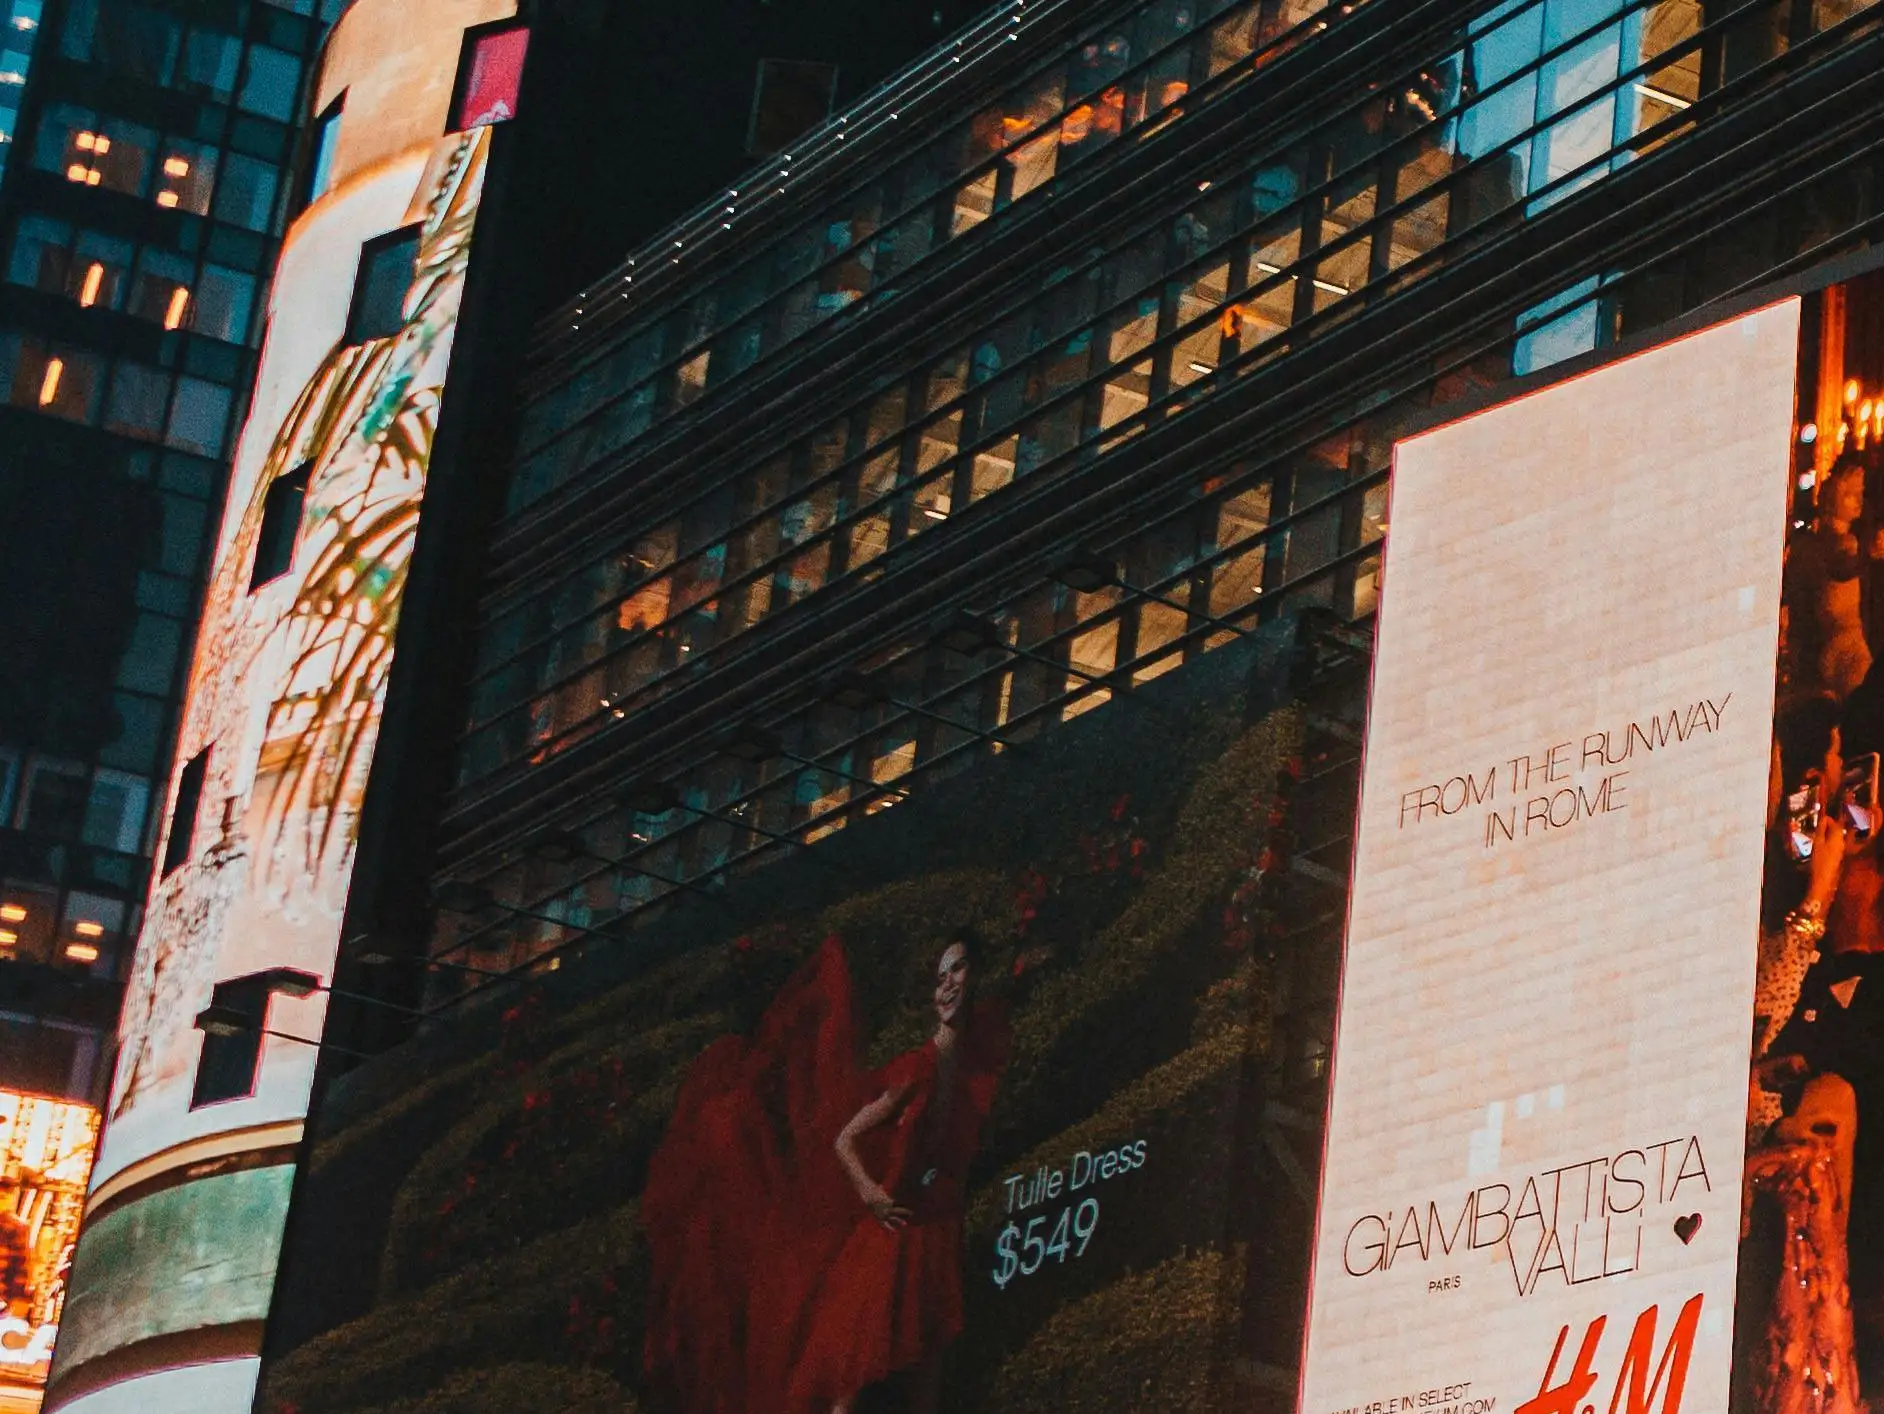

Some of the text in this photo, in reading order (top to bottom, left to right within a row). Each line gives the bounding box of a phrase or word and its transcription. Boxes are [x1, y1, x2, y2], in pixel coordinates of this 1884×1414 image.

[1399, 691, 1734, 830] FROM THE RUNWAY
[1485, 770, 1630, 849] IN ROME
[1003, 1139, 1147, 1214] Tulle Dress
[993, 1198, 1100, 1290] $549
[1427, 1274, 1462, 1294] PARIS
[1401, 1393, 1416, 1411] IN
[1418, 1381, 1472, 1409] SELECT
